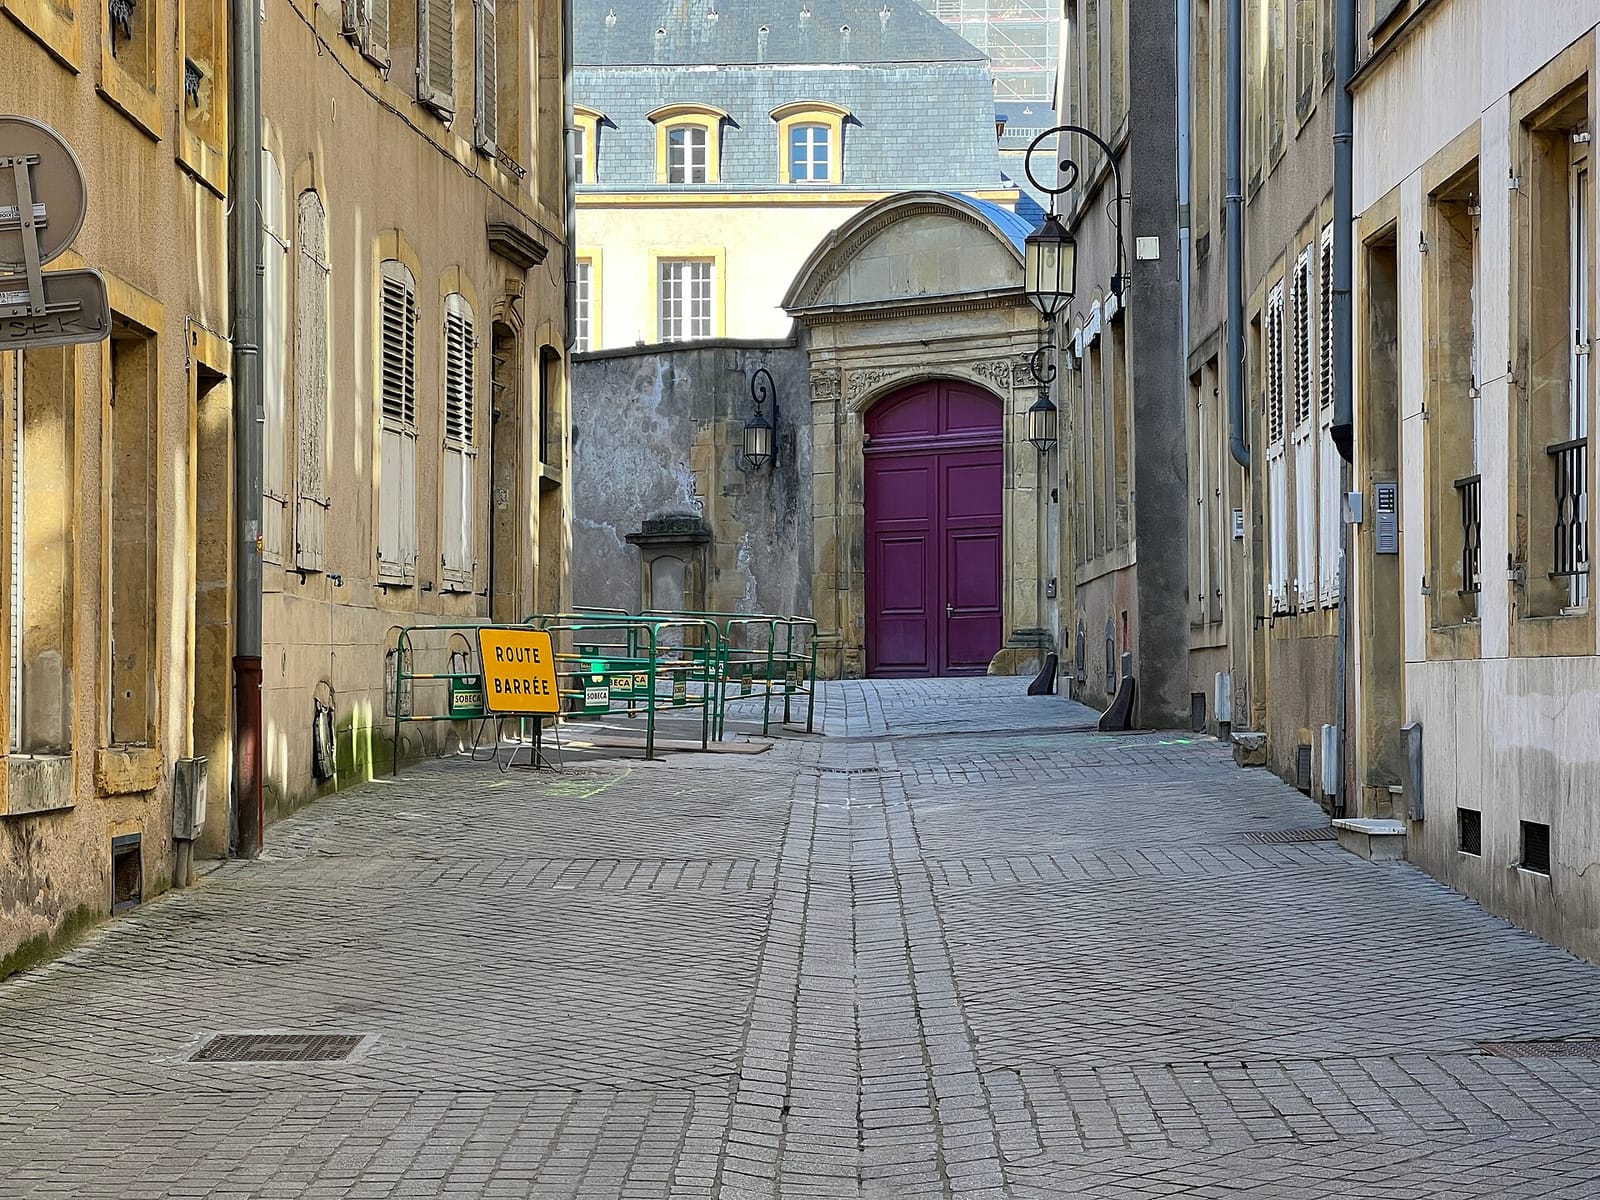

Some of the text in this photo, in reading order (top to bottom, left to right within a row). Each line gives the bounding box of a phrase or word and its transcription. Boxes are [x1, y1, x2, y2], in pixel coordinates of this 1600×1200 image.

[495, 646, 541, 664] ROUTE
[494, 676, 550, 695] BARRÉE
[455, 694, 481, 703] SOBECA
[586, 692, 607, 700] SOBECA
